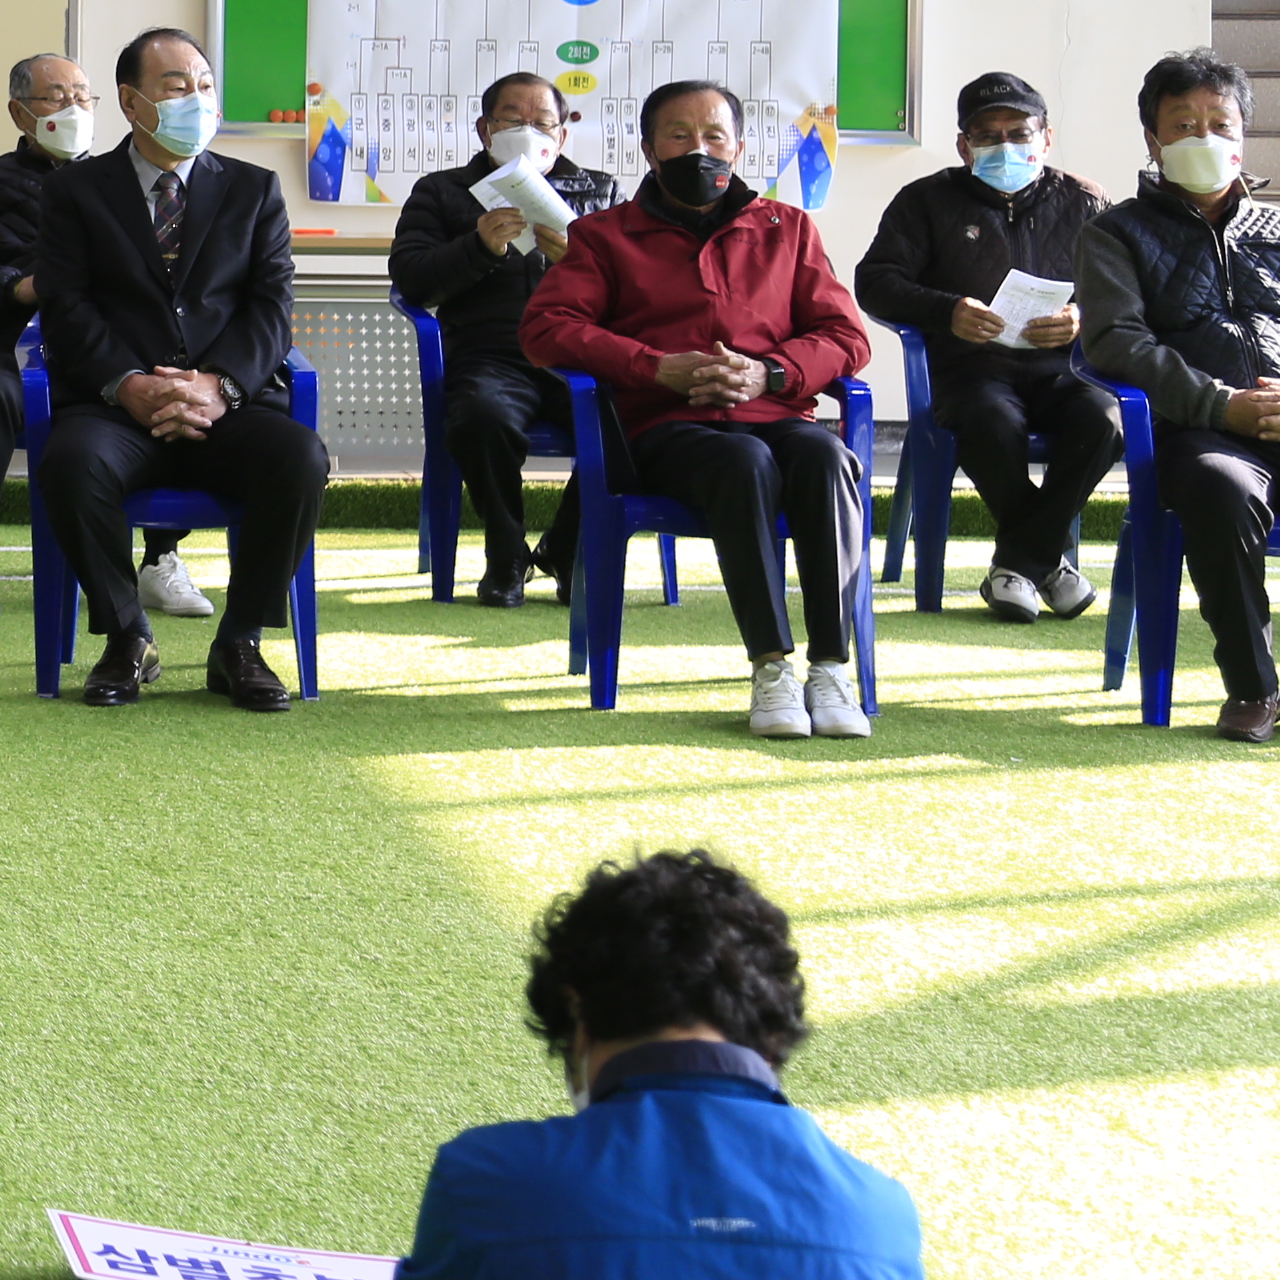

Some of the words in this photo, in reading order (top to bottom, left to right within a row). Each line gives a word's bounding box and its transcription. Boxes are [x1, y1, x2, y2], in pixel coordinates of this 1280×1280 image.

[348, 4, 359, 12] 2-1
[372, 43, 388, 51] 2-1A
[432, 43, 448, 52] 2-2A
[521, 44, 537, 53] 2-4A
[568, 46, 590, 59] 2회전
[391, 71, 407, 79] 1-1A
[568, 76, 589, 89] 1회전
